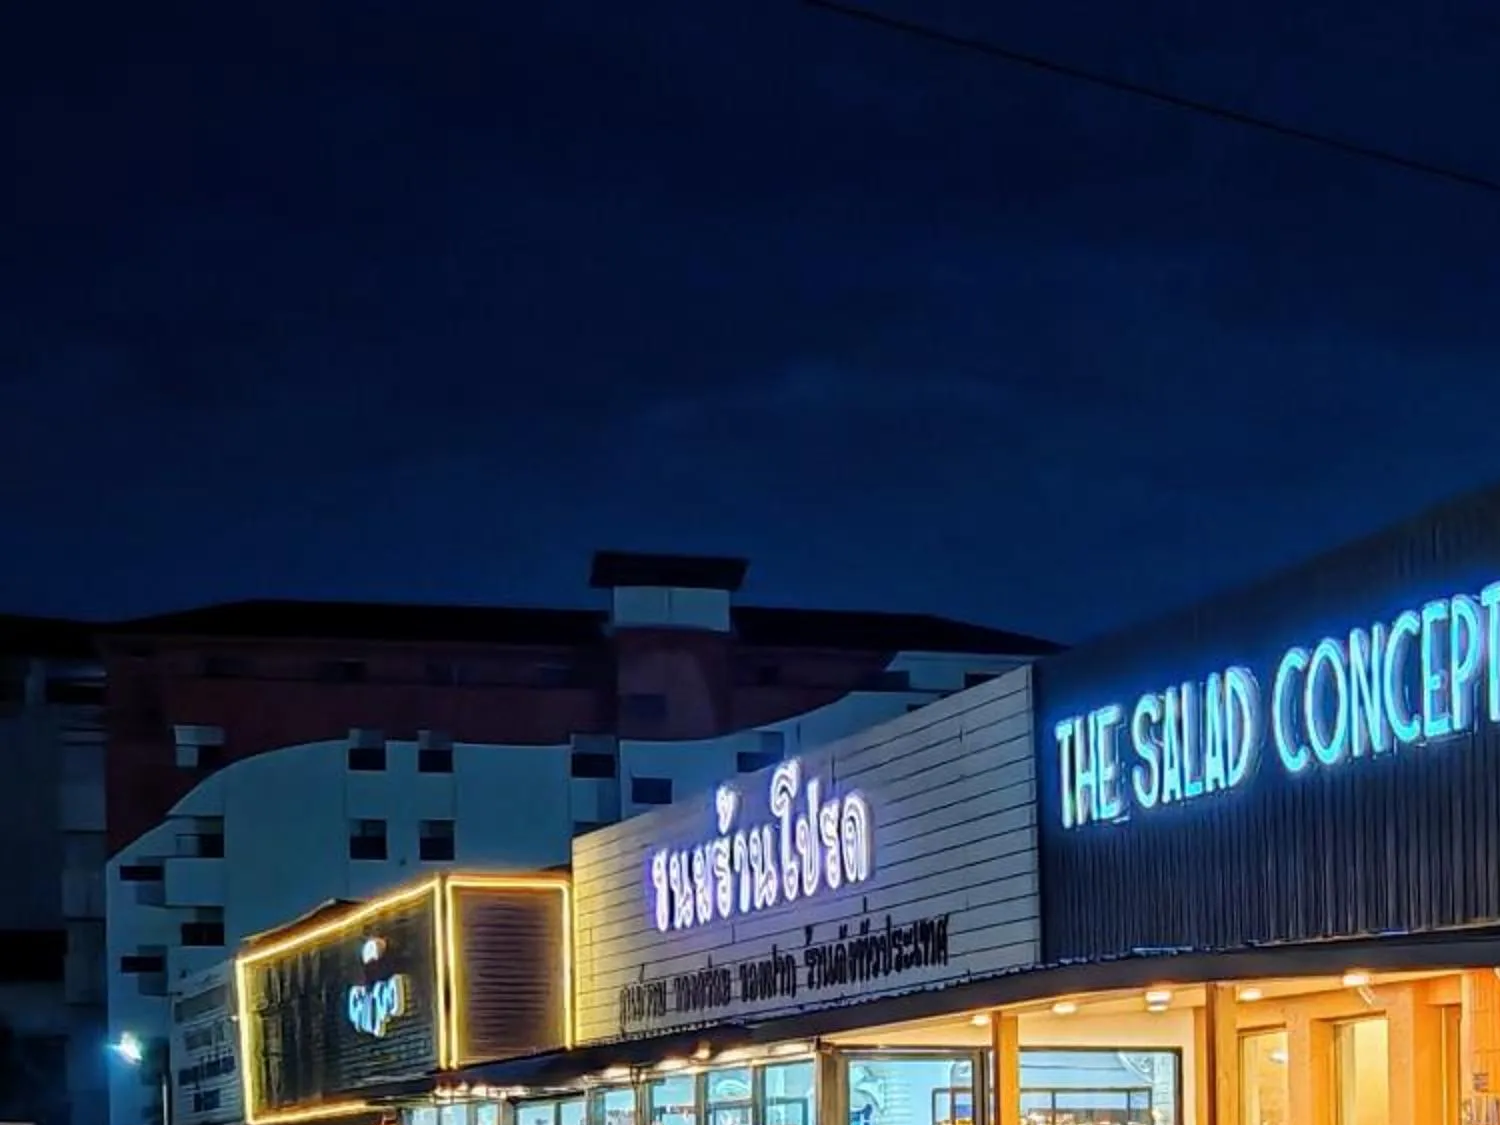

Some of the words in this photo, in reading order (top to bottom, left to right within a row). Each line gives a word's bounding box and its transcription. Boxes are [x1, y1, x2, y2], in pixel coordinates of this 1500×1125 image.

[1055, 704, 1122, 829] THE
[1131, 666, 1258, 809] SALAD
[652, 757, 875, 932] ขนมร้านโปรด
